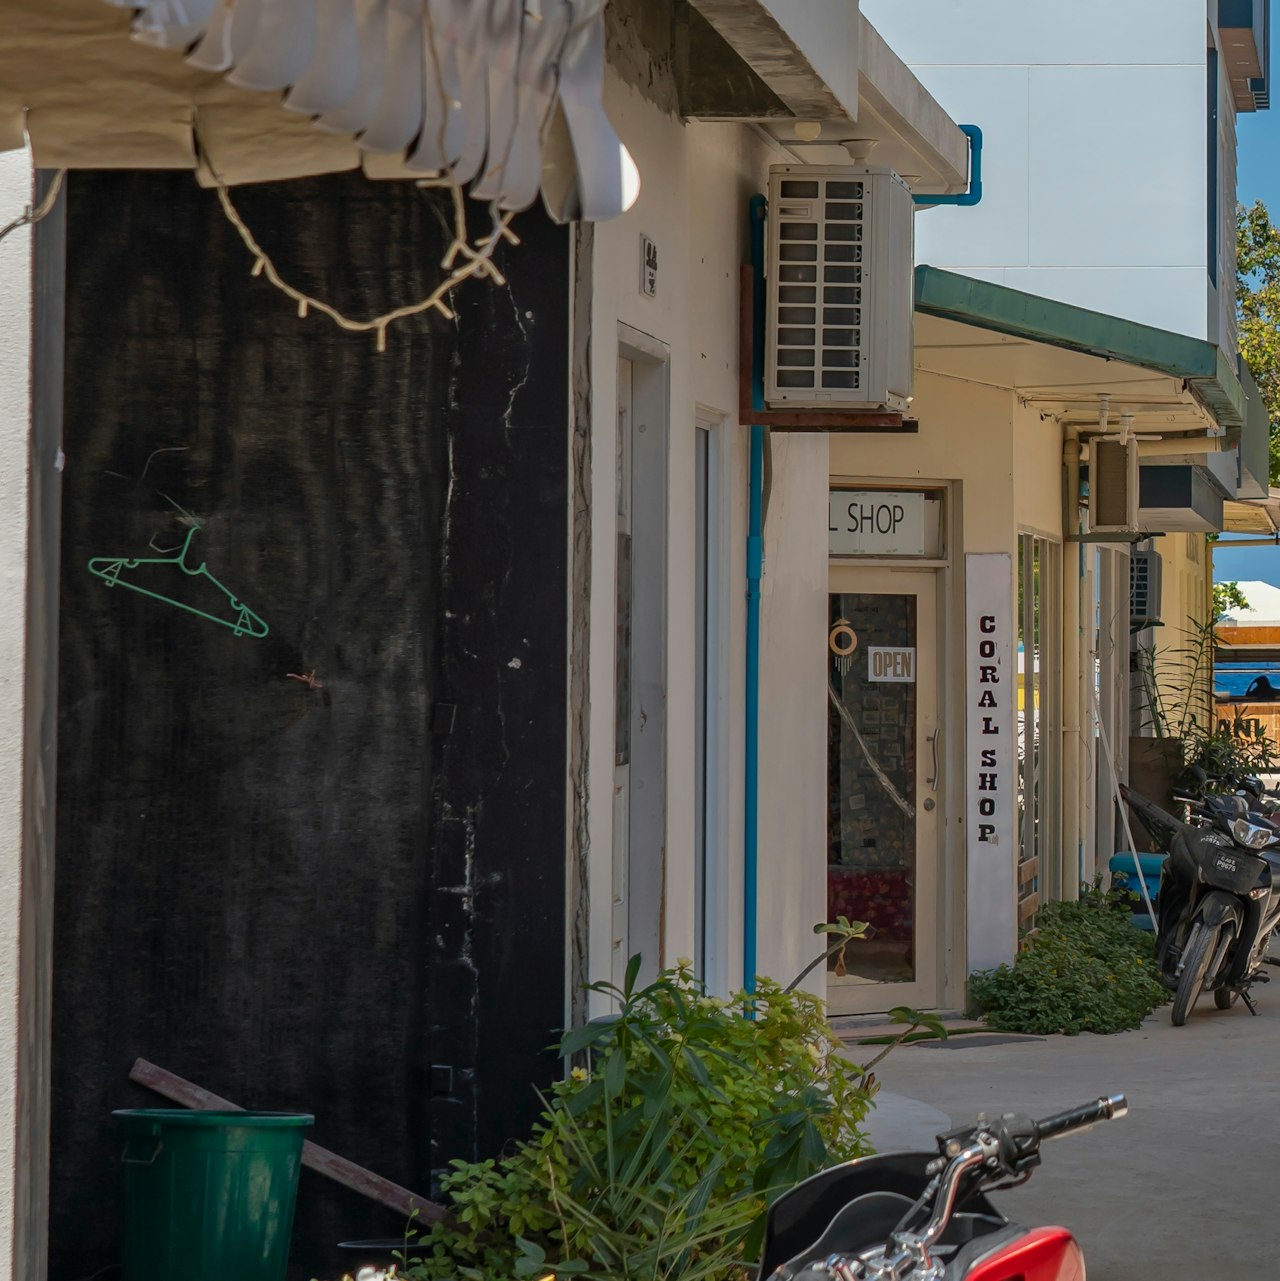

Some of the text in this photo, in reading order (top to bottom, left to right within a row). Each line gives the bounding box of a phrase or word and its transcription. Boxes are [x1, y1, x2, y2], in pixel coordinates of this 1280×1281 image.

[847, 502, 904, 534] SHOP
[872, 651, 912, 678] OPEN
[978, 616, 999, 842] CORAL SHOP
